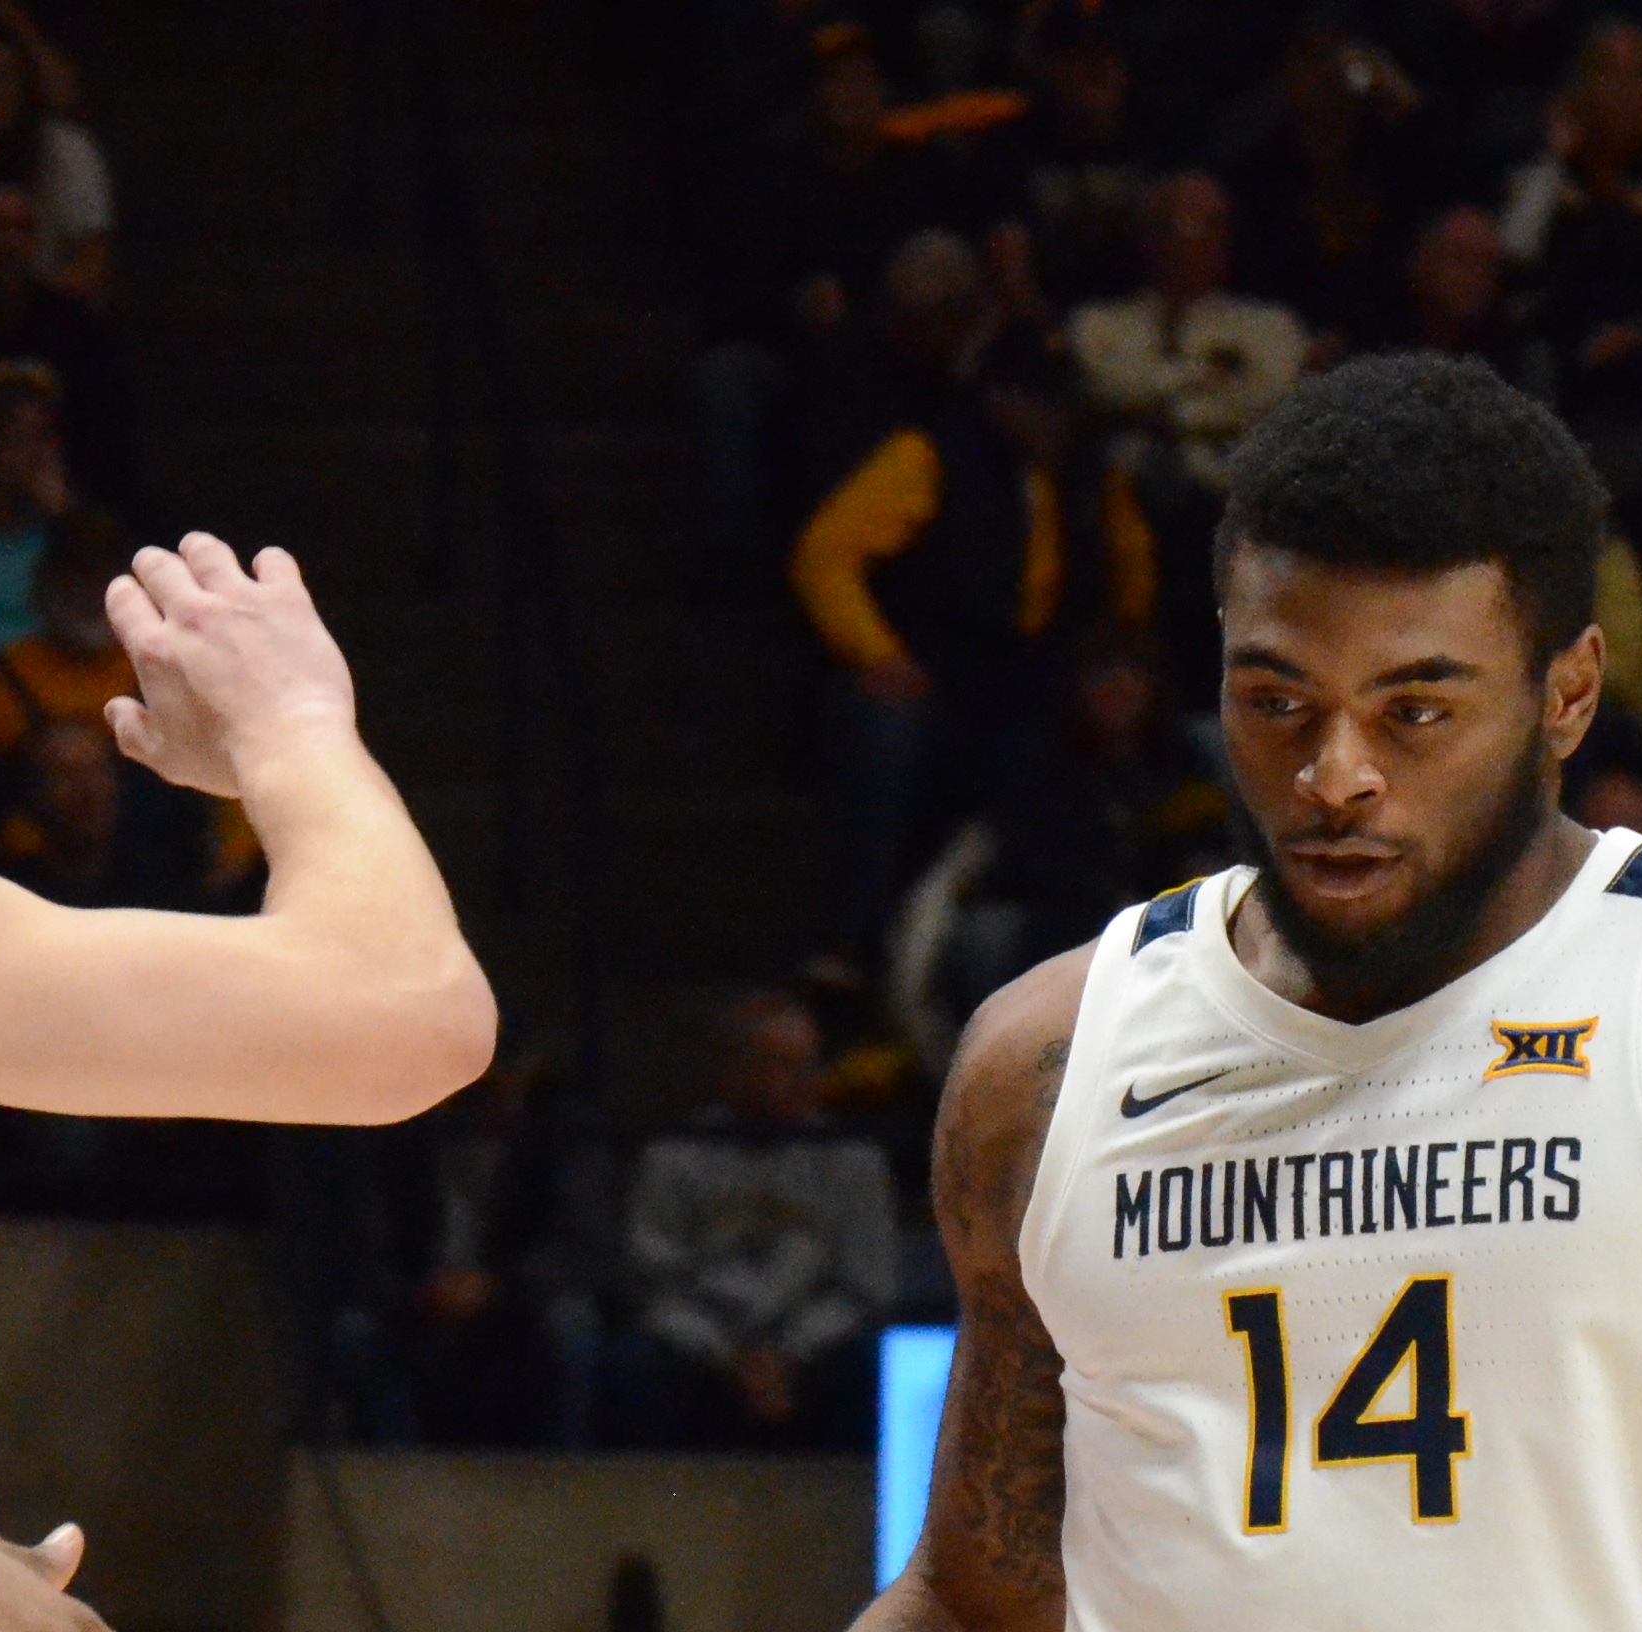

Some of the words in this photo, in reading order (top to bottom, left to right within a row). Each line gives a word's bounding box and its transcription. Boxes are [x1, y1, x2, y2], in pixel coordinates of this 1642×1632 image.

[1491, 1020, 1593, 1075] XII
[1112, 1136, 1583, 1260] MOUNTAINEERS
[1222, 1271, 1472, 1536] 14
